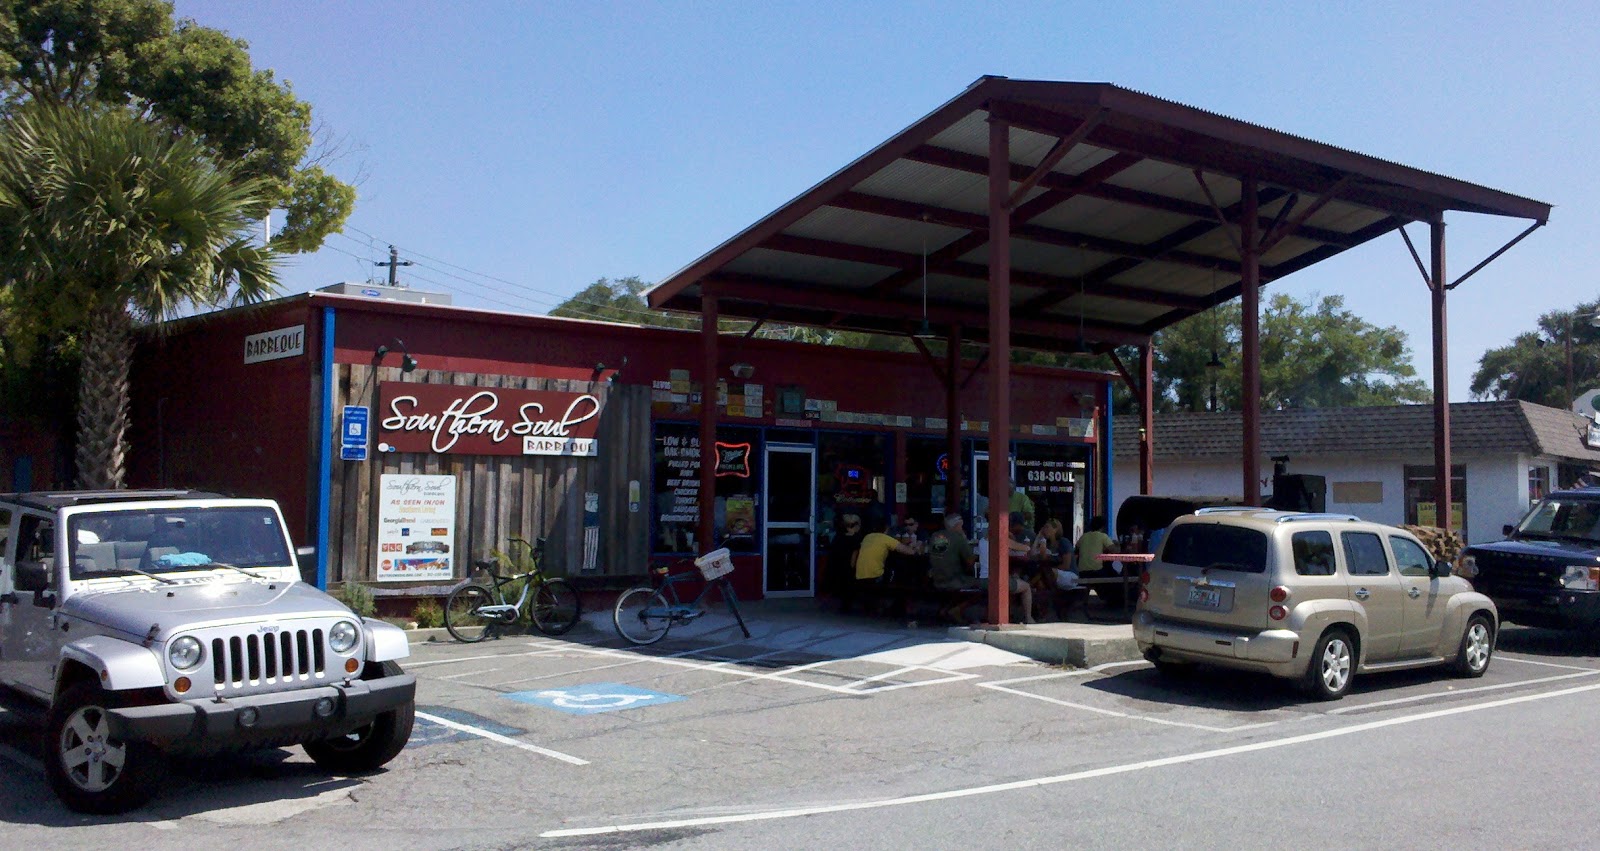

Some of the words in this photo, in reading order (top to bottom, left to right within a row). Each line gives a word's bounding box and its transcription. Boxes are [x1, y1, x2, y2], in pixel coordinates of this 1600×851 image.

[246, 331, 302, 357] BARBEQUE
[381, 391, 510, 453] Southern
[512, 394, 600, 436] Soul
[526, 440, 595, 453] BARBEQUE
[386, 478, 424, 496] Southern
[424, 476, 452, 491] Soul
